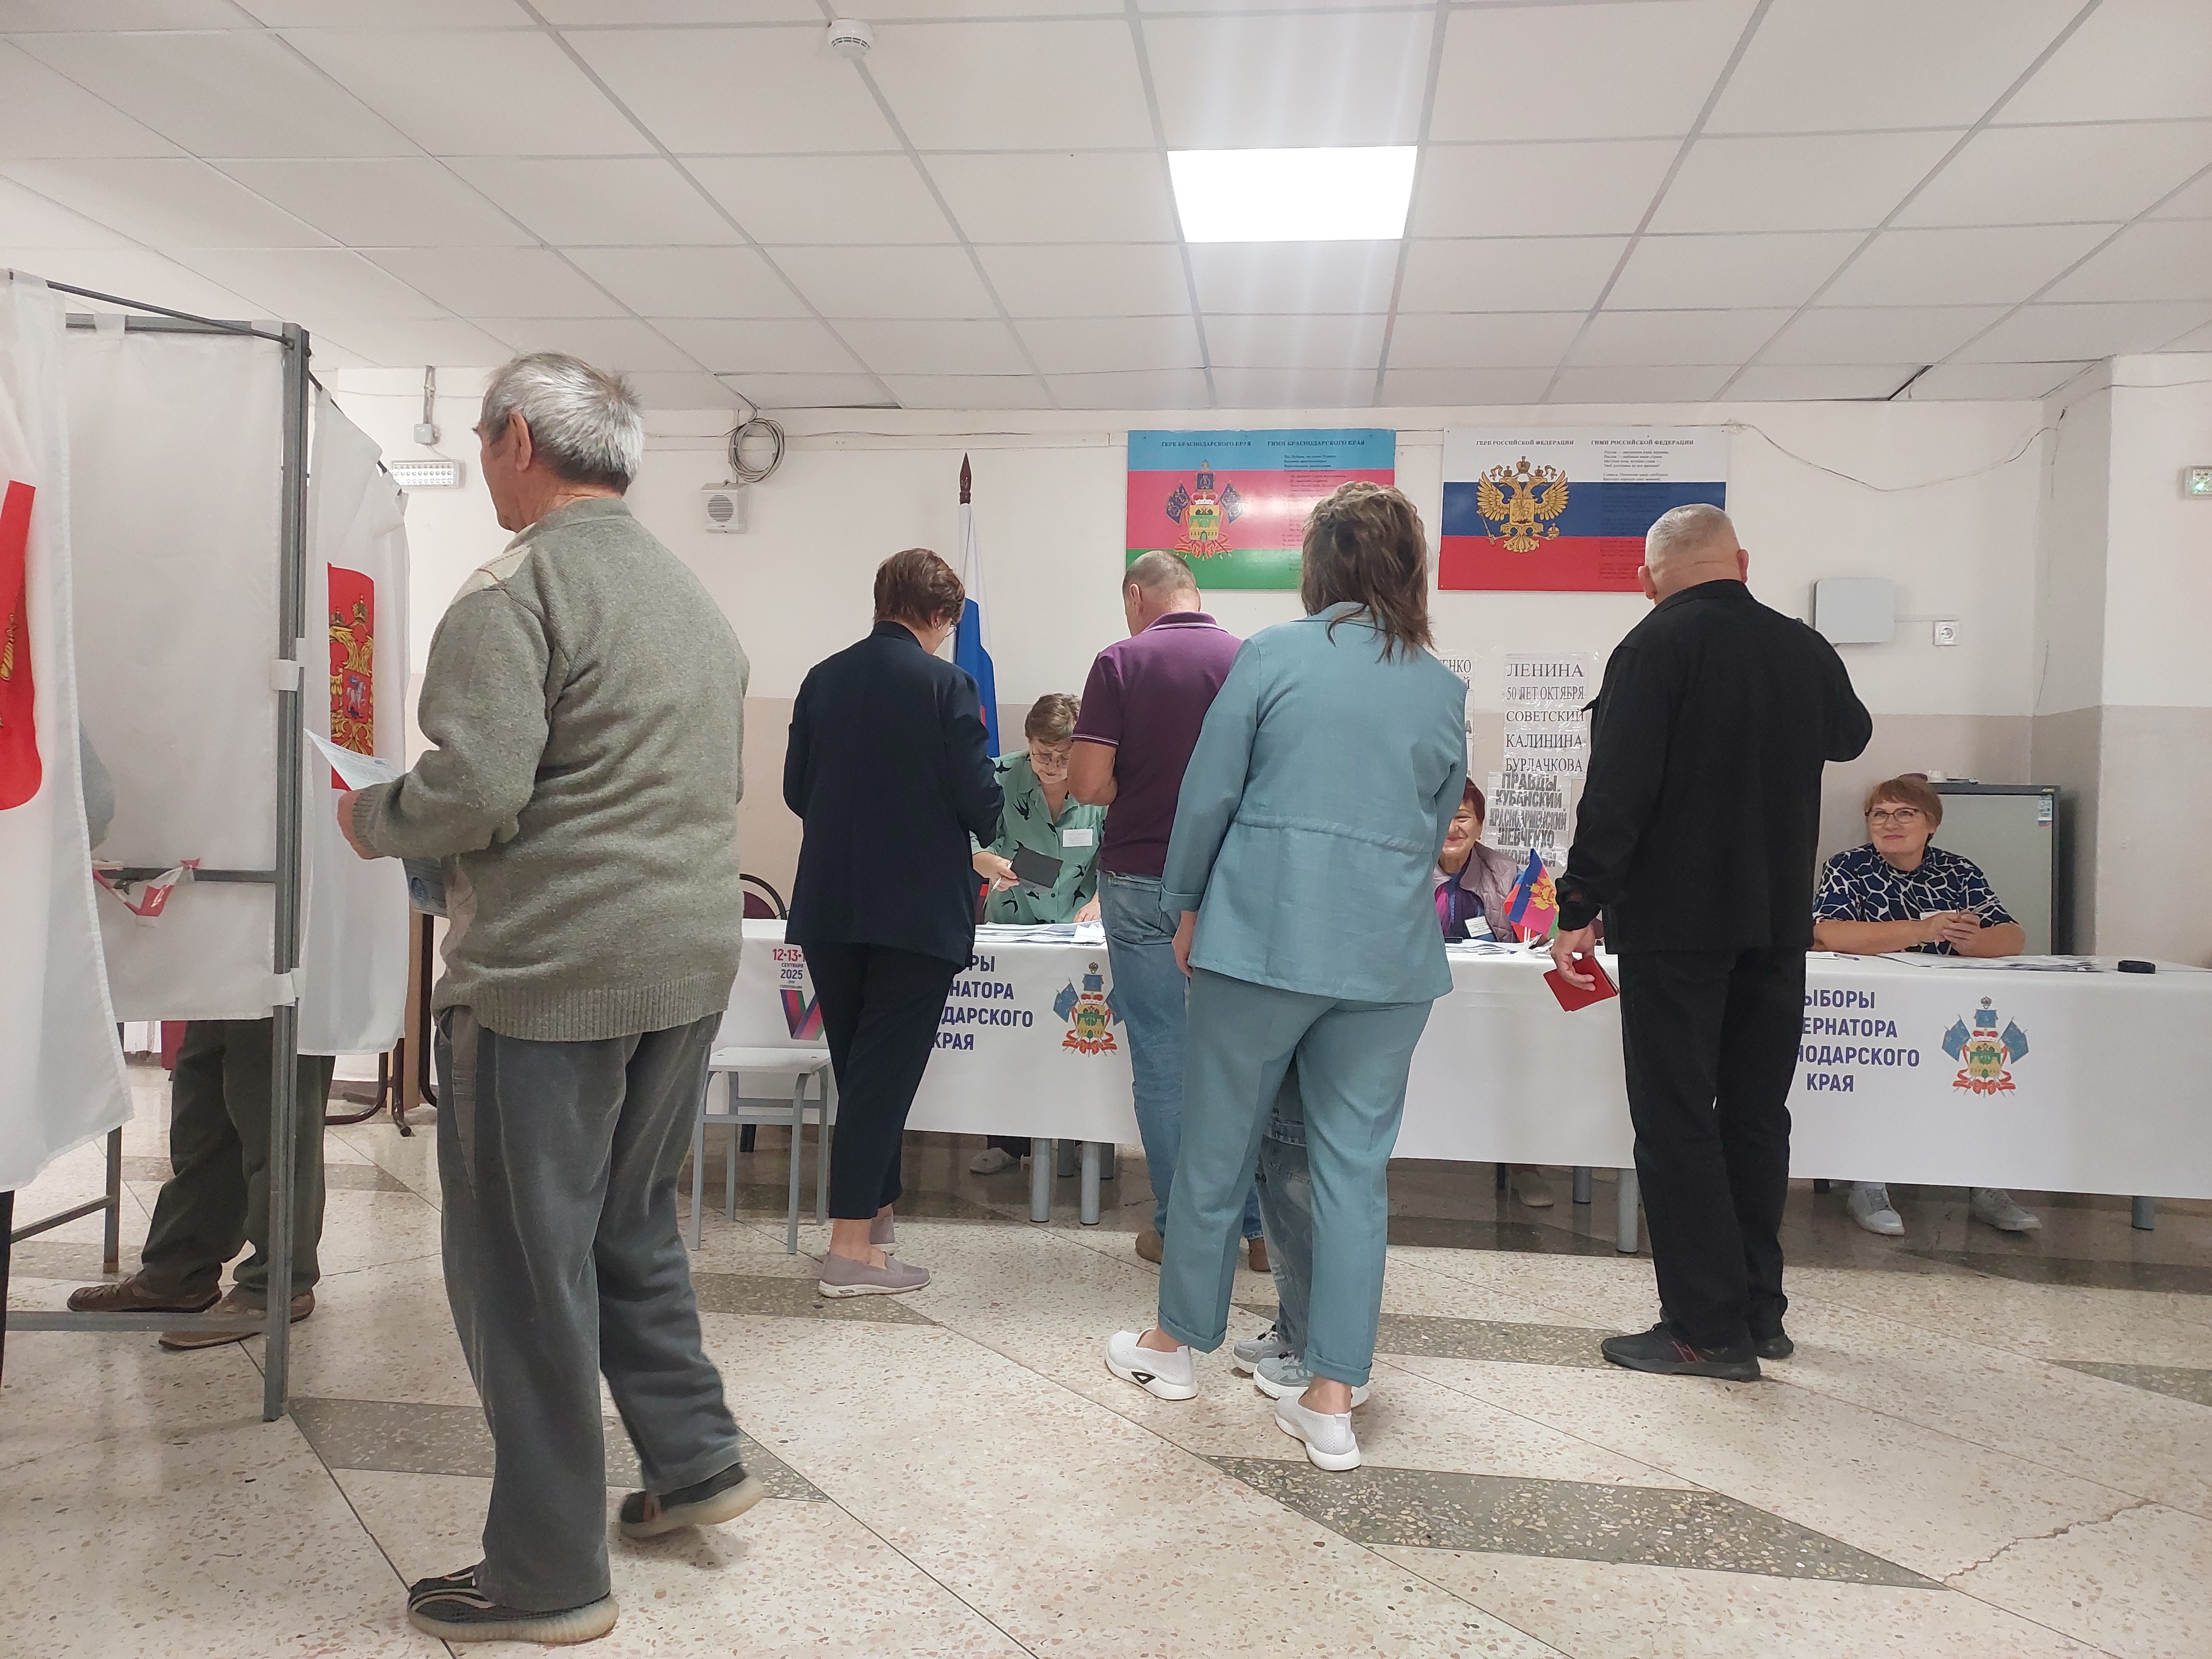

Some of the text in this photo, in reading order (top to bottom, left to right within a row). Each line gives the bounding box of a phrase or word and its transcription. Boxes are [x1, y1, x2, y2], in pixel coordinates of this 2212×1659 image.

[1506, 664, 1584, 677] ЛЕНИНА
[1506, 686, 1584, 700] 50 ЛЕТ ОКТЯБРЯ
[1506, 708, 1584, 722] СОВЕТСКИЙ
[1505, 734, 1582, 748] КАЛИНИНА
[1505, 758, 1583, 772] БУРЛАЧКОВА
[1501, 772, 1558, 792] ПРАВДЫ
[1495, 788, 1562, 808] КУБАНСКИЙ
[780, 969, 803, 980] 2025
[950, 980, 1014, 1000] НАТОРА
[1804, 989, 1875, 1009] ЫБОРЫ
[941, 1006, 1033, 1028] ДАРСКОГО
[1803, 1017, 1898, 1038] ЕРНАТОРА
[933, 1032, 974, 1051] КРАЯ
[1807, 1073, 1854, 1092] КРАЯ
